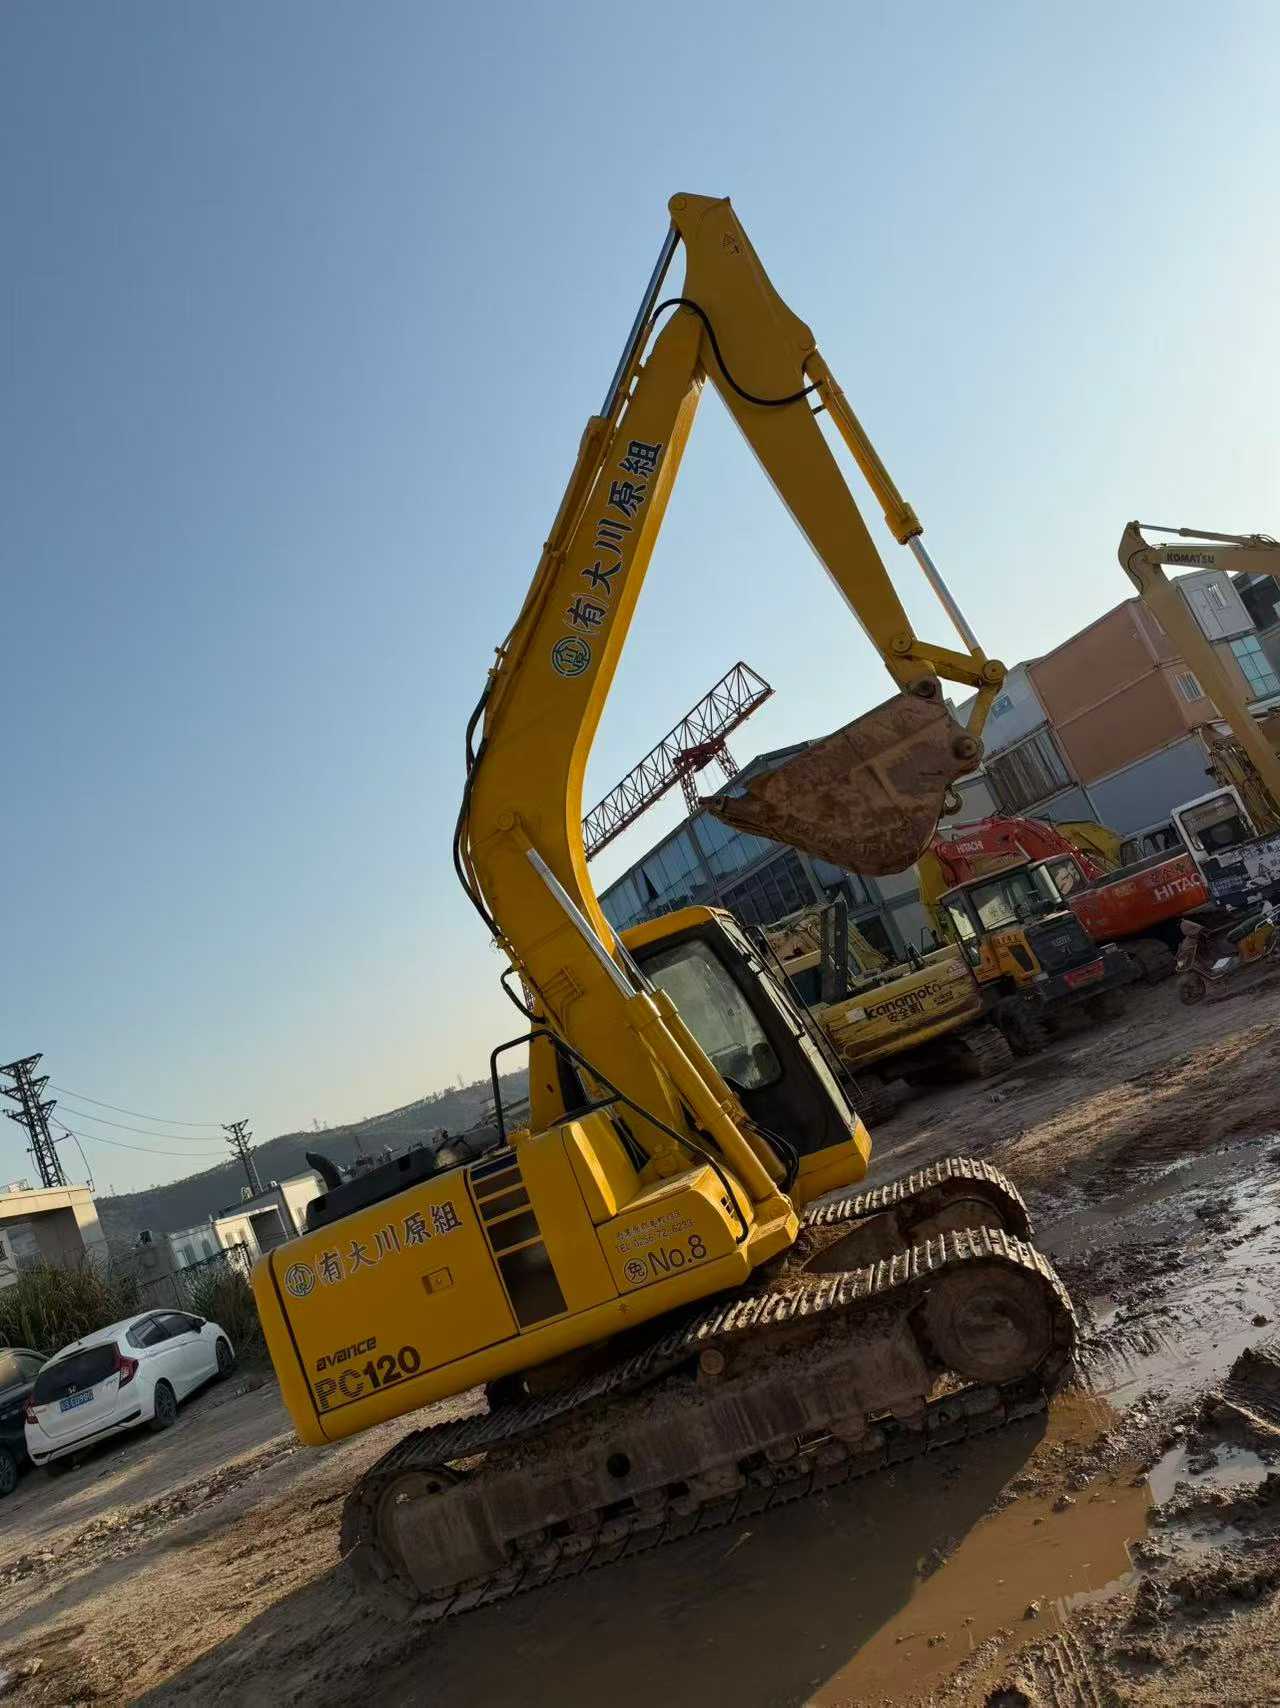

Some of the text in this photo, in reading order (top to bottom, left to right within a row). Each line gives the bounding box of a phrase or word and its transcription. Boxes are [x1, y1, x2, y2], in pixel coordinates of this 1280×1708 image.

[1166, 552, 1215, 564] KOMATSU
[864, 982, 941, 1020] kanamoto
[648, 1234, 707, 1274] No.8
[316, 1335, 377, 1372] avance
[313, 1345, 422, 1410] PC120
